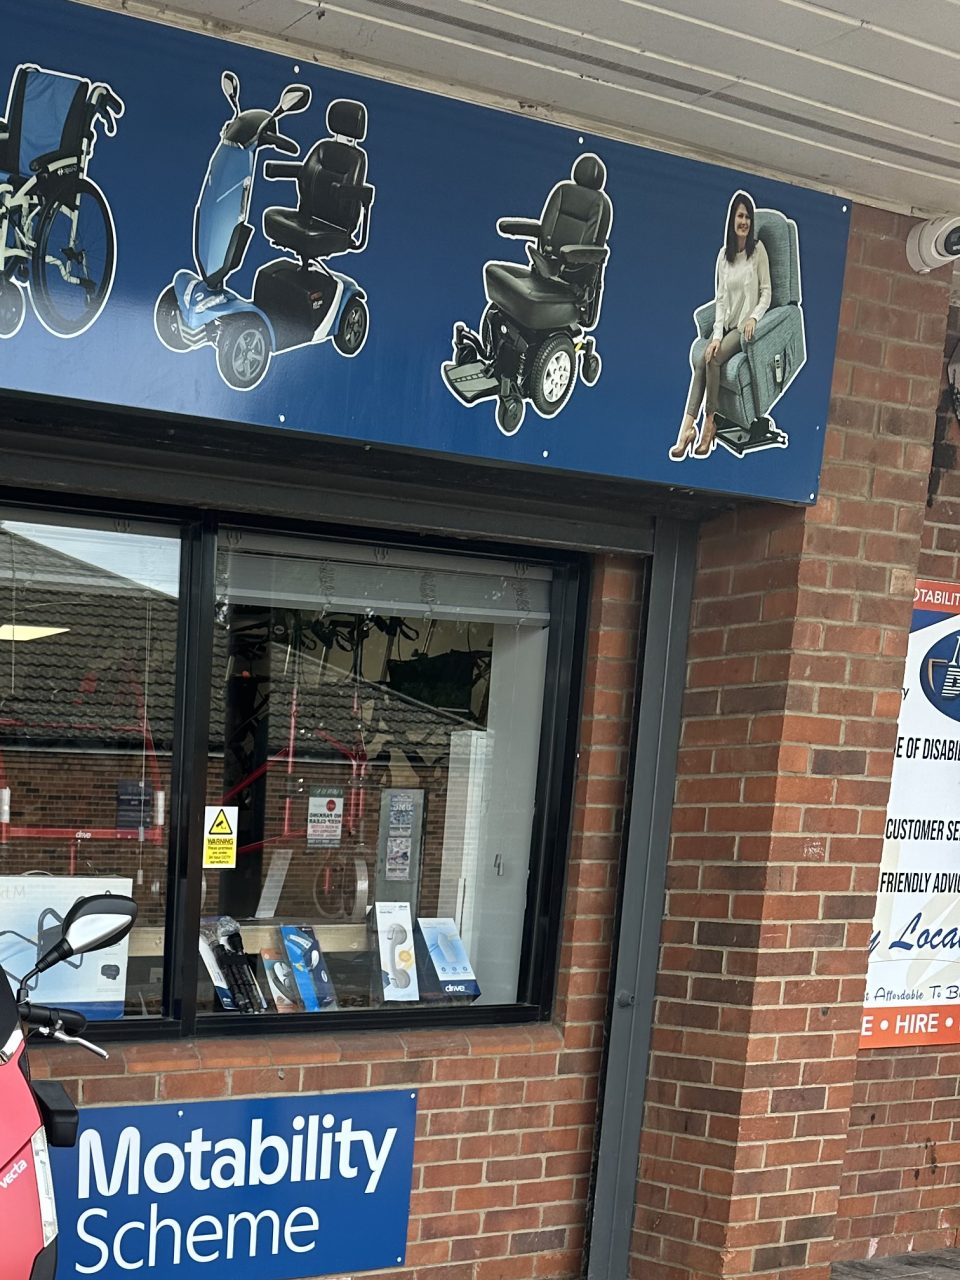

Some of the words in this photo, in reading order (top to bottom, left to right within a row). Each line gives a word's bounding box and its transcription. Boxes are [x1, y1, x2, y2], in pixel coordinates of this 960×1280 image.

[906, 737, 922, 759] OF
[922, 738, 960, 761] DISABI
[75, 830, 92, 839] drive
[885, 818, 945, 841] CUSTOMER
[880, 872, 931, 893] FRIENDLY
[888, 911, 960, 951] Loca
[444, 983, 466, 993] drive
[874, 986, 924, 1001] Affordable
[929, 985, 941, 999] To
[895, 1012, 940, 1034] HIRE
[77, 1113, 398, 1199] Motability
[75, 1202, 319, 1274] Scheme
